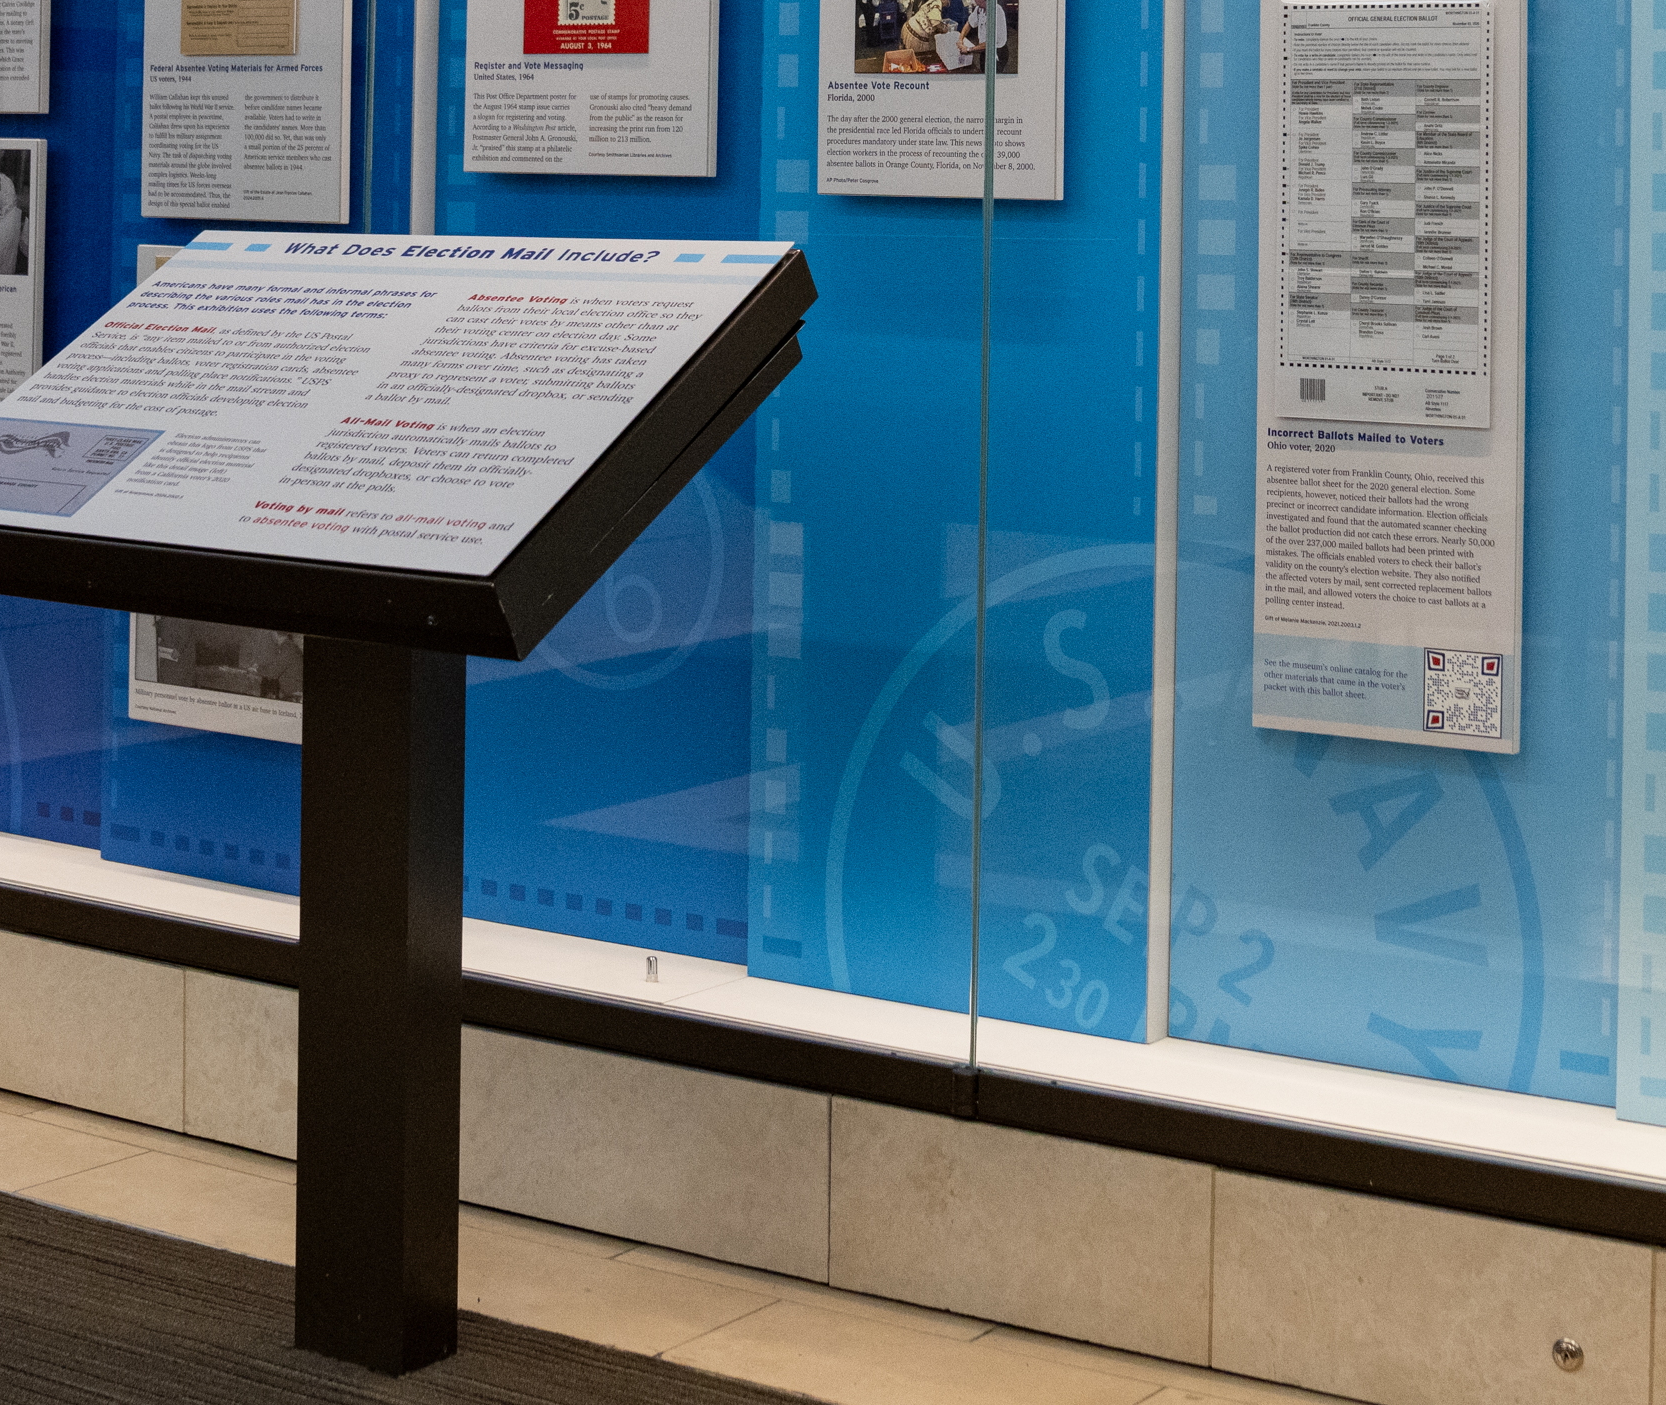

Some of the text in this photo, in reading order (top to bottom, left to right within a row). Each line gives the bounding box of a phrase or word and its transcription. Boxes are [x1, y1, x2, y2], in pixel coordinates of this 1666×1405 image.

[149, 63, 324, 73] Federal Absentee Voting Materials for Armed Forces
[473, 61, 584, 71] Register and Vote Messaging
[827, 80, 930, 90] Absentee Vote Recount
[827, 93, 876, 103] Florida, 2000
[284, 242, 661, 263] What Does Election Mail Include?
[468, 293, 568, 305] Absentee Voting
[341, 416, 435, 431] All-Mail Voting
[1267, 427, 1445, 447] Incorrect Ballots Mailed to Voters
[1266, 440, 1337, 453] Ohio voter, 2020
[1266, 464, 1485, 485] A registered voter from Franklin County, Ohio, received this
[254, 500, 346, 517] Voting by mail
